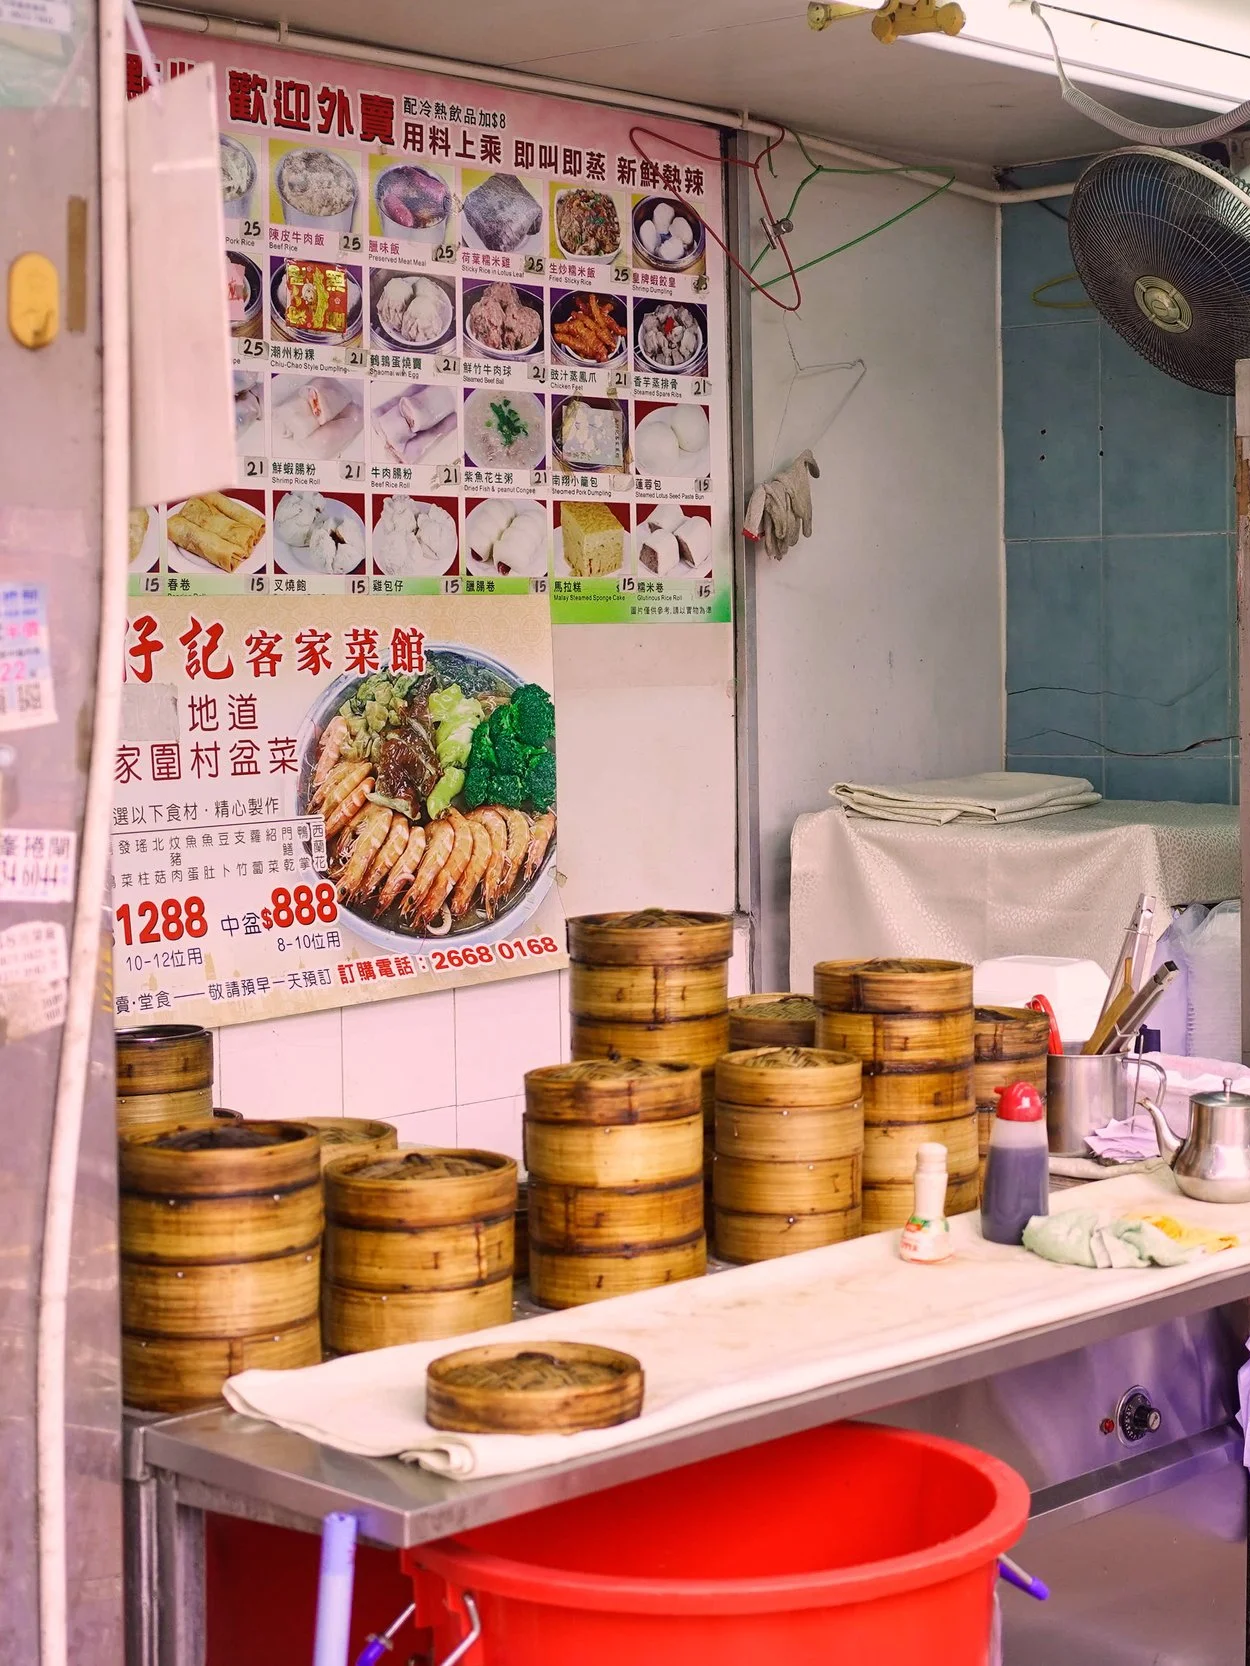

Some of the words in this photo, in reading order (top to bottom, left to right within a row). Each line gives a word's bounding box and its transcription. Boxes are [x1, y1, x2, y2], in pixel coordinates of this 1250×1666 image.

[229, 70, 395, 146] 歡迎外賣
[403, 96, 507, 129] 配冷熱飲品加$8
[403, 122, 502, 165] 用料上乘
[514, 140, 606, 182] 即叫即蒸
[617, 157, 705, 196] 新鮮熱辣
[244, 220, 261, 237] 25
[241, 238, 255, 247] Rice
[269, 227, 325, 247] 陳皮牛肉飯
[343, 235, 361, 251] 25
[269, 241, 283, 250] Beef
[284, 243, 298, 252] Rice
[438, 245, 454, 259] 25
[369, 253, 399, 264] Preserved
[399, 257, 413, 266] Meat
[413, 259, 427, 267] Meal
[461, 251, 511, 269] 荷葉糯米雞
[529, 257, 544, 272] 25
[461, 265, 478, 275] Sticky
[479, 267, 491, 275] Rice
[497, 269, 512, 277] Lotus
[512, 270, 525, 278] Leaf
[549, 262, 596, 279] 生炒糯米飯
[614, 268, 629, 282] 25
[549, 275, 562, 283] Fried
[564, 276, 579, 286] Sticky
[580, 278, 592, 286] Rice
[632, 272, 676, 289] 皇牌蝦餃皇
[632, 284, 649, 294] Shrimp
[650, 286, 673, 296] Dumpling
[243, 339, 264, 356] 25
[271, 360, 302, 369] Chiu-Chao
[303, 362, 319, 371] Style
[350, 352, 363, 365] 21
[443, 358, 456, 372] 21
[408, 371, 419, 380] Egg
[463, 362, 512, 377] 鮮竹牛肉球
[533, 366, 546, 379] 21
[463, 375, 484, 384] Steamed
[484, 377, 495, 385] Beef
[550, 382, 570, 390] Chicken
[615, 373, 627, 386] 21
[633, 375, 678, 390] 香芋蒸排骨
[633, 389, 655, 397] Steamed
[694, 380, 706, 395] 21
[247, 461, 263, 476] 21
[345, 464, 360, 479] 21
[443, 467, 458, 484] 21
[271, 476, 293, 485] Shrimp
[294, 477, 308, 485] Rice
[308, 478, 321, 486] Roll
[371, 480, 384, 488] Beef
[385, 481, 398, 489] Rice
[534, 471, 547, 484] 21
[515, 487, 536, 495] Congee
[551, 487, 575, 496] Steamed
[587, 489, 612, 497] Dumpling
[145, 577, 160, 592] 15
[167, 578, 191, 592] 春卷
[250, 577, 265, 592] 15
[351, 579, 366, 593] 15
[445, 579, 460, 593] 15
[535, 580, 547, 593] 15
[554, 581, 582, 592] 馬拉糕
[623, 577, 635, 591] 15
[637, 582, 664, 593] 糯米卷
[592, 594, 612, 602] Sponge
[699, 585, 711, 598] 15
[187, 692, 259, 733] 地道
[114, 736, 300, 785] 家圍村盆菜
[115, 895, 209, 946] 1288
[276, 930, 341, 952] 8-10位用
[126, 947, 204, 972] 10-12位用
[431, 945, 494, 972] 2668
[498, 936, 559, 961] 0168
